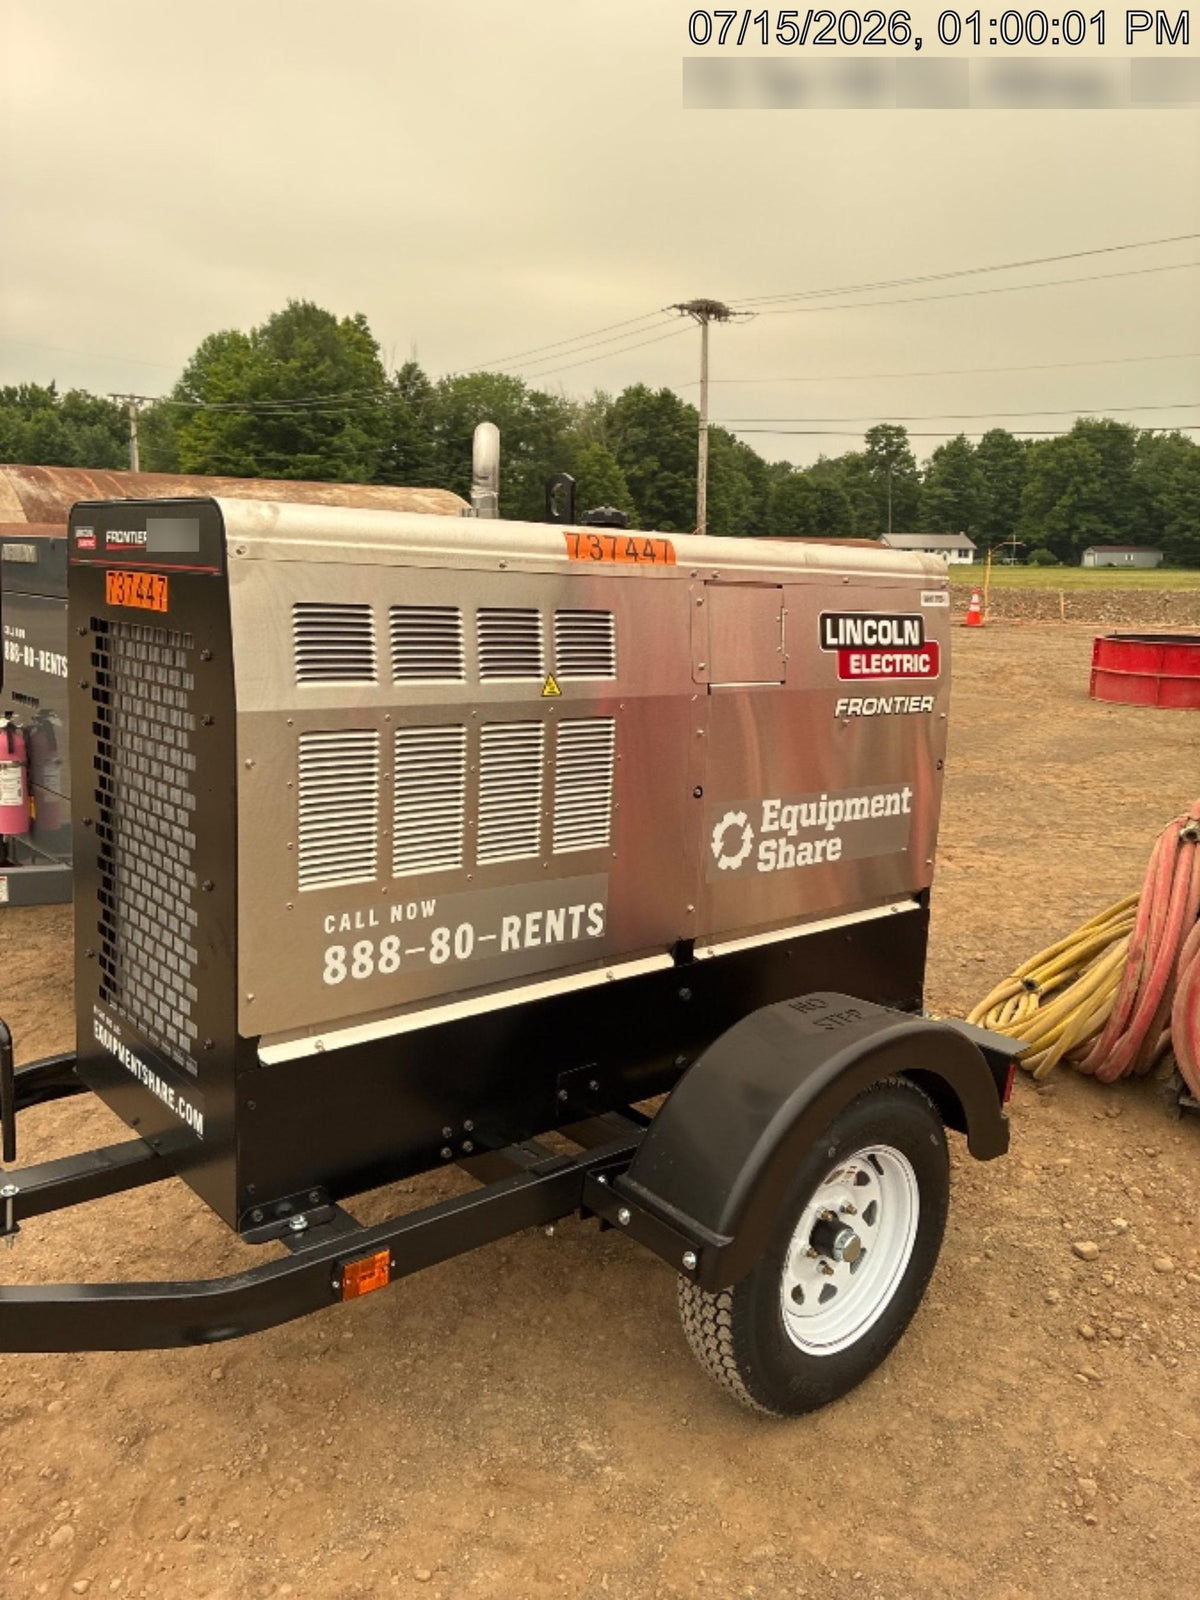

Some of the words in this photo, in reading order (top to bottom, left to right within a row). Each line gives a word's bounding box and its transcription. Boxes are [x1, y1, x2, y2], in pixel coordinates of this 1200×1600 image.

[566, 532, 669, 565] 737447
[108, 572, 166, 610] 737447
[825, 617, 920, 646] LINCOLN
[849, 653, 931, 675] ELECTRIC
[834, 695, 936, 719] FRONTIER
[760, 787, 913, 836] Equipment
[757, 836, 842, 872] Share
[324, 908, 379, 934] CALL
[390, 899, 437, 923] NOW
[322, 902, 606, 986] 888-80-RENTS
